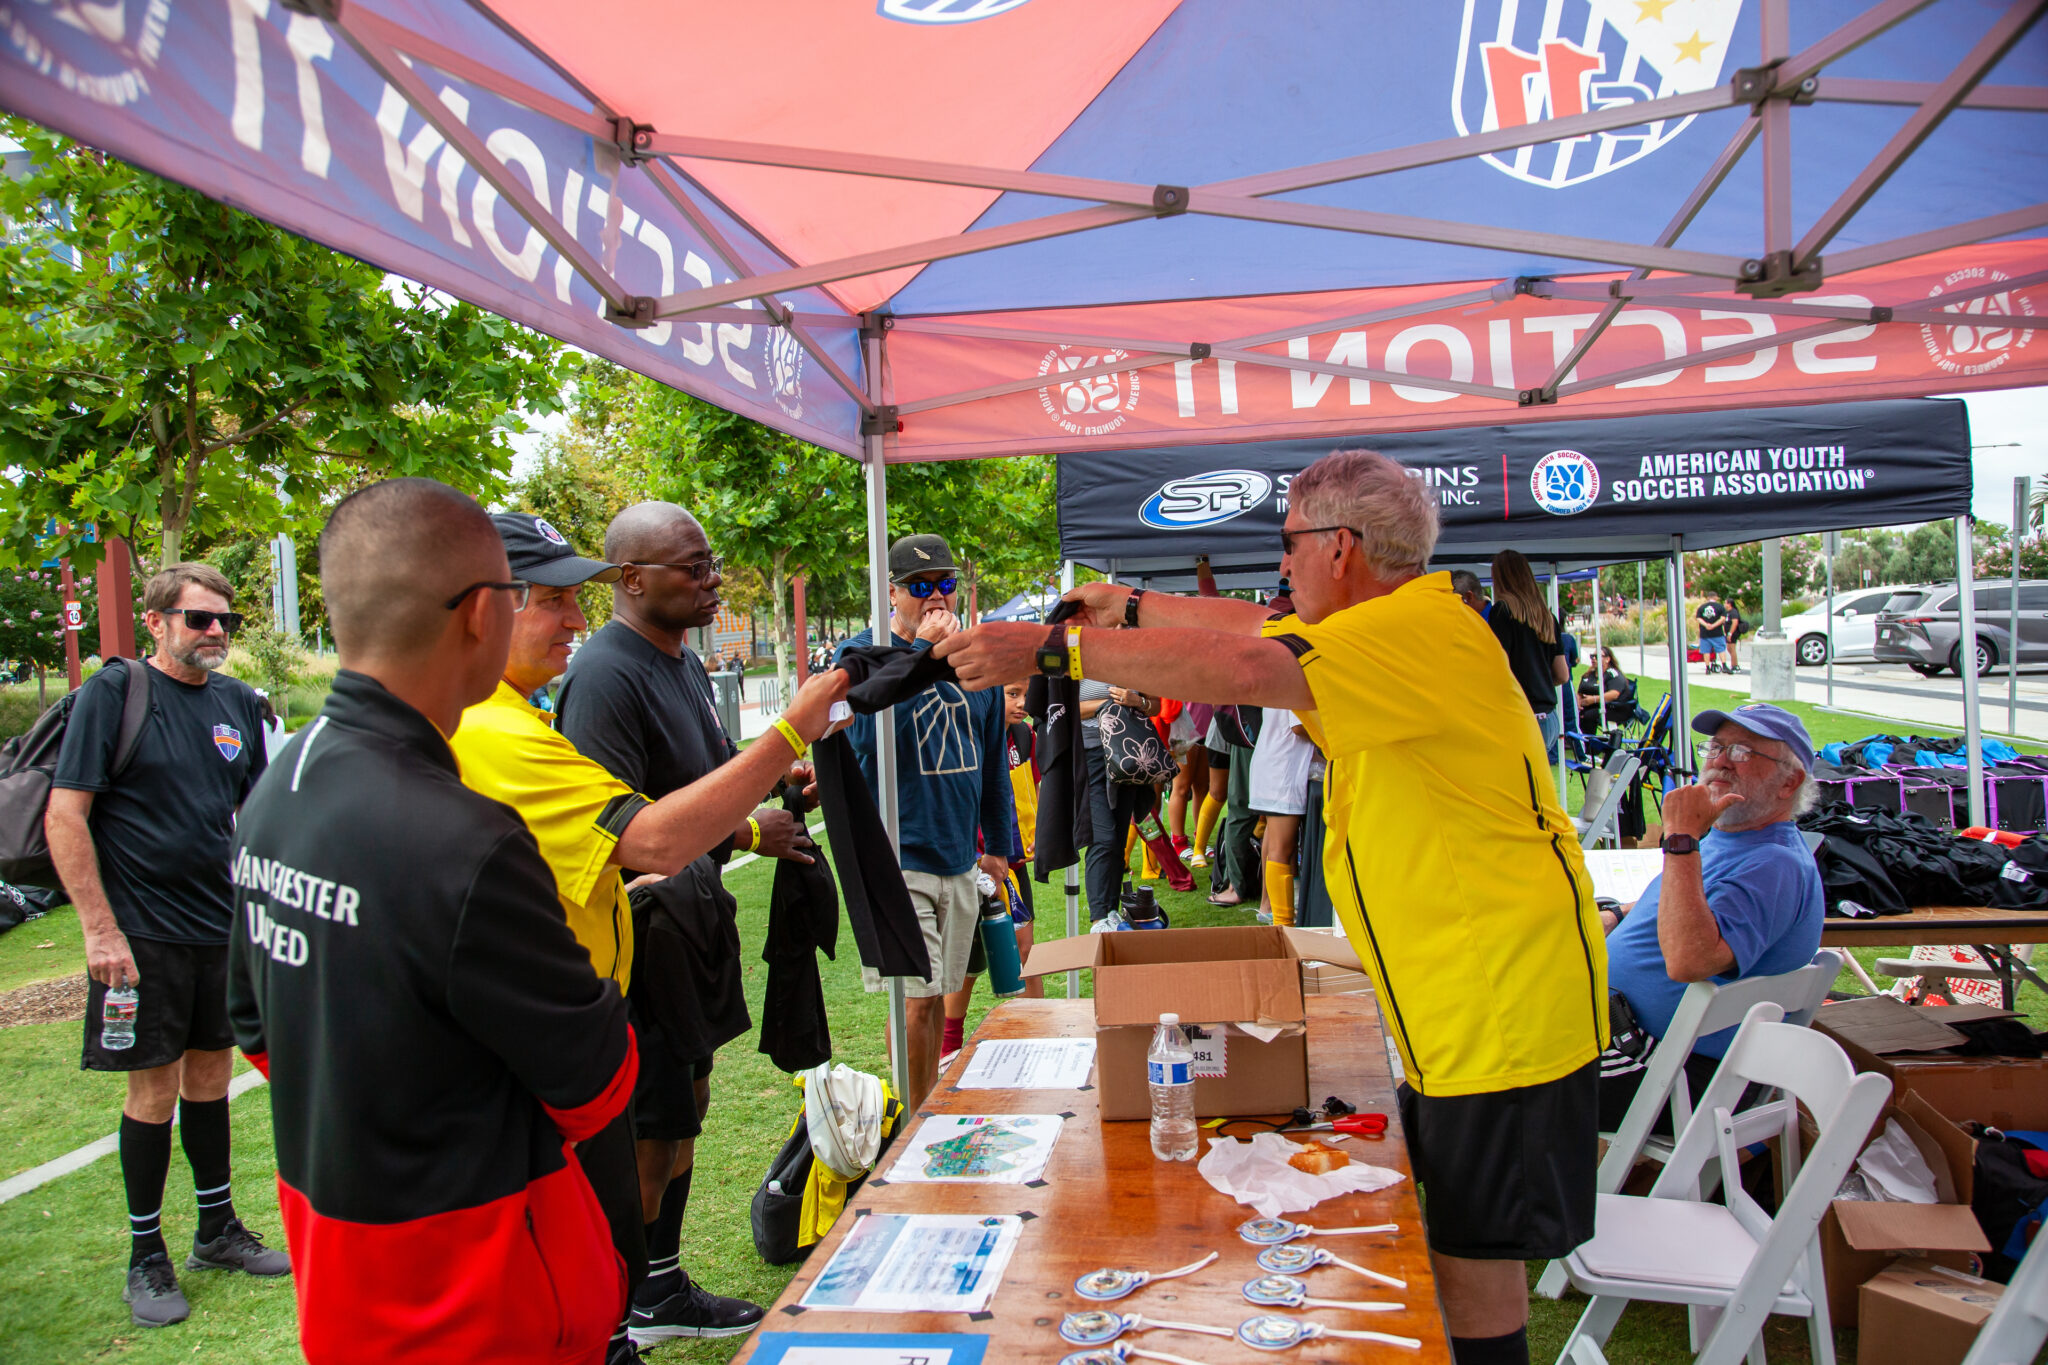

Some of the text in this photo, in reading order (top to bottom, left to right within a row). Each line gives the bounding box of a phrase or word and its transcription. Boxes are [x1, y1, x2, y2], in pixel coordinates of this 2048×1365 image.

[1537, 454, 1555, 470] YOUTH
[1557, 451, 1582, 461] SOCCER
[1638, 445, 1846, 478] AMERICAN YOUTH
[1442, 489, 1481, 505] INC.
[1612, 476, 1706, 502] SOCCER
[70, 612, 79, 622] 14
